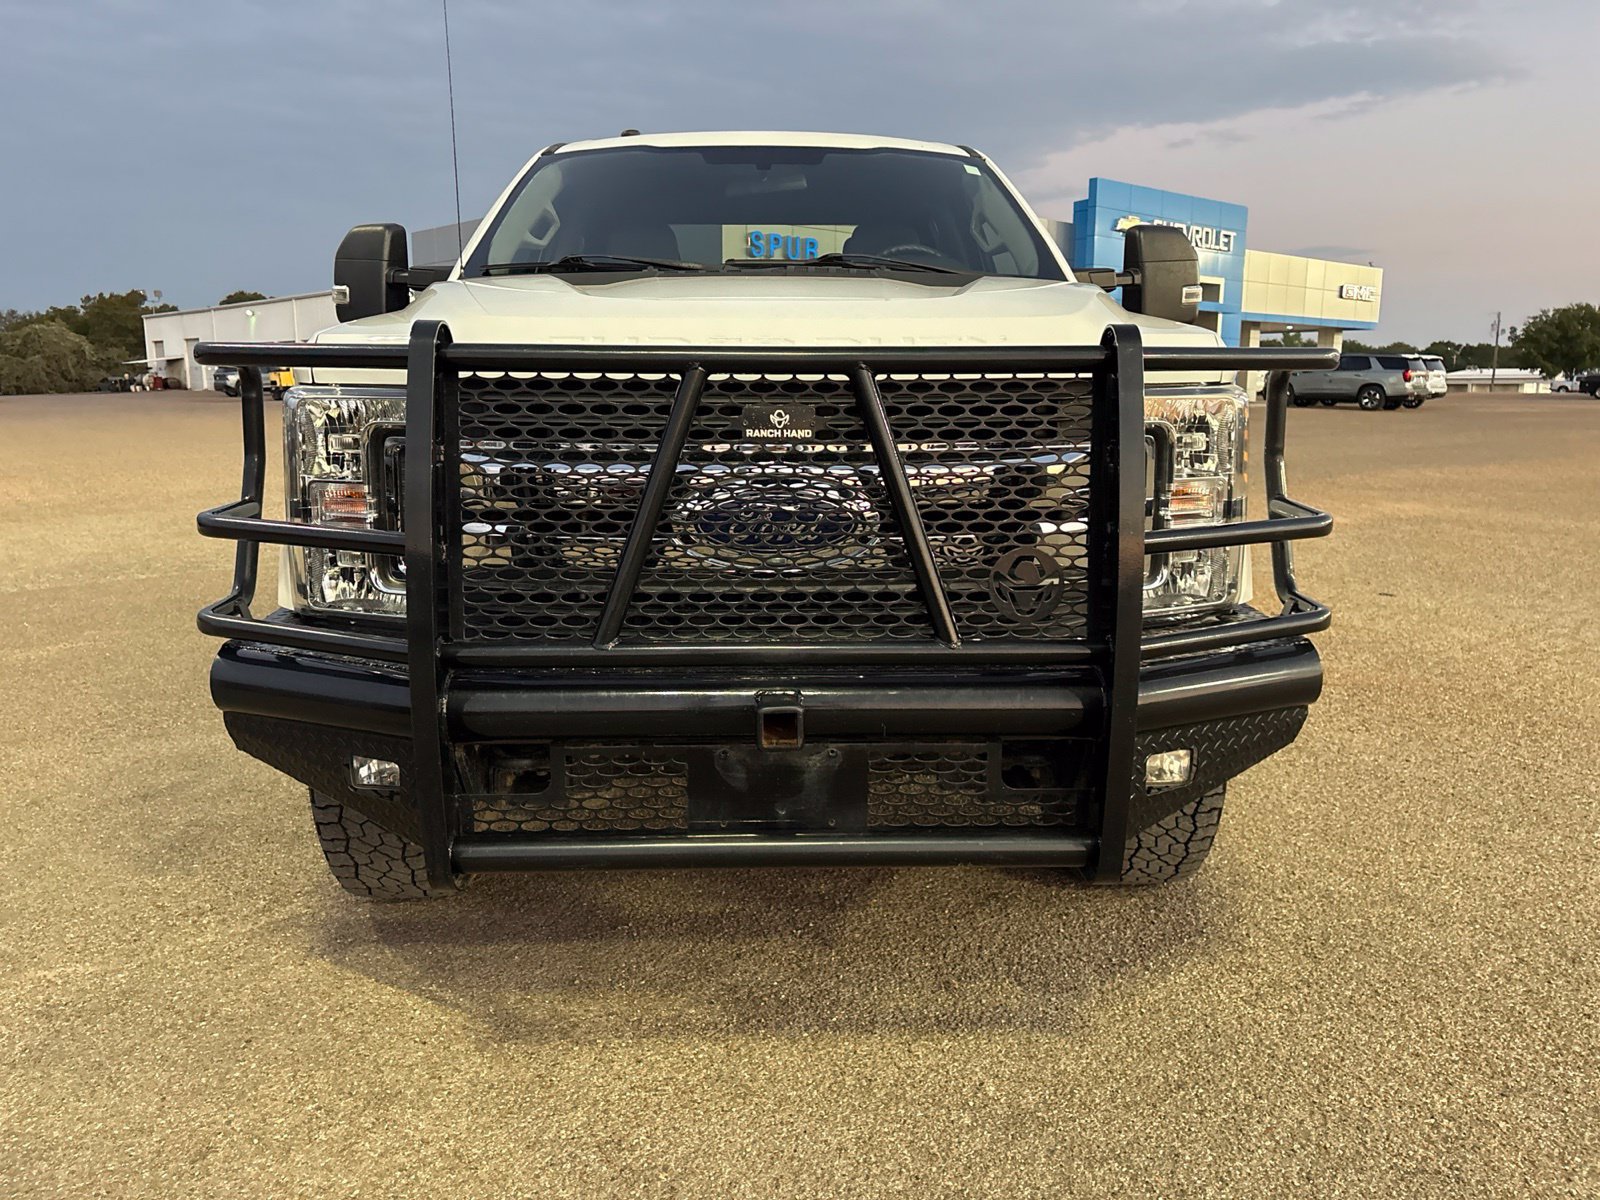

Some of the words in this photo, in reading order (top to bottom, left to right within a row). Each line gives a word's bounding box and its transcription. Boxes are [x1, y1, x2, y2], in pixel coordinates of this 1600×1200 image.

[749, 230, 819, 260] SPUR
[1153, 219, 1237, 253] VROLET
[745, 428, 782, 438] RANCH
[783, 429, 812, 439] HAND
